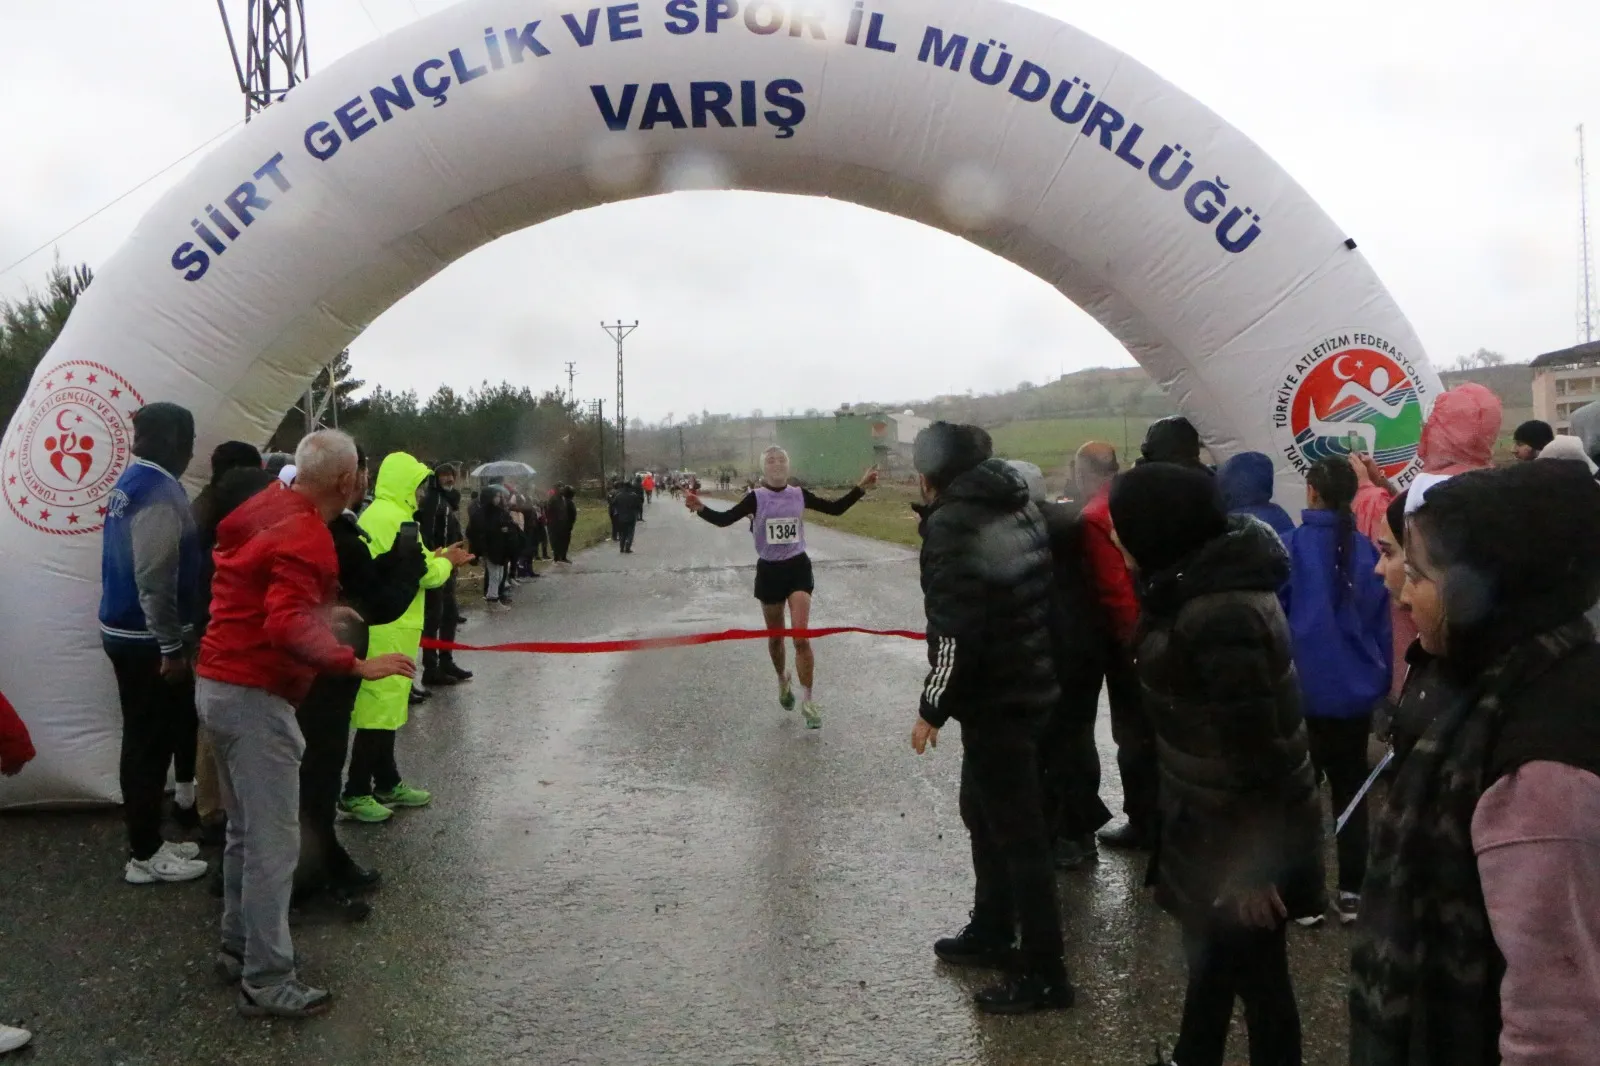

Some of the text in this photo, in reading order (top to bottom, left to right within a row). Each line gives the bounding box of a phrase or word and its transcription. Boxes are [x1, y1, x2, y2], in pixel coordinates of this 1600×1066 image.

[590, 78, 806, 139] VARIŞ
[170, 0, 1262, 282] SİİRT GENÇLİK VE SPOR İL MÜDÜRLÜĞÜ
[55, 391, 97, 408] GENÇLİK
[1272, 333, 1426, 428] TÜRKİYE ATLETİZM FEDERASYONU
[97, 402, 111, 416] VE
[107, 415, 126, 445] SPOR
[87, 446, 126, 499] BAKANLIĞI
[1283, 444, 1424, 487] TURK FEDE
[769, 524, 796, 540] 1384
